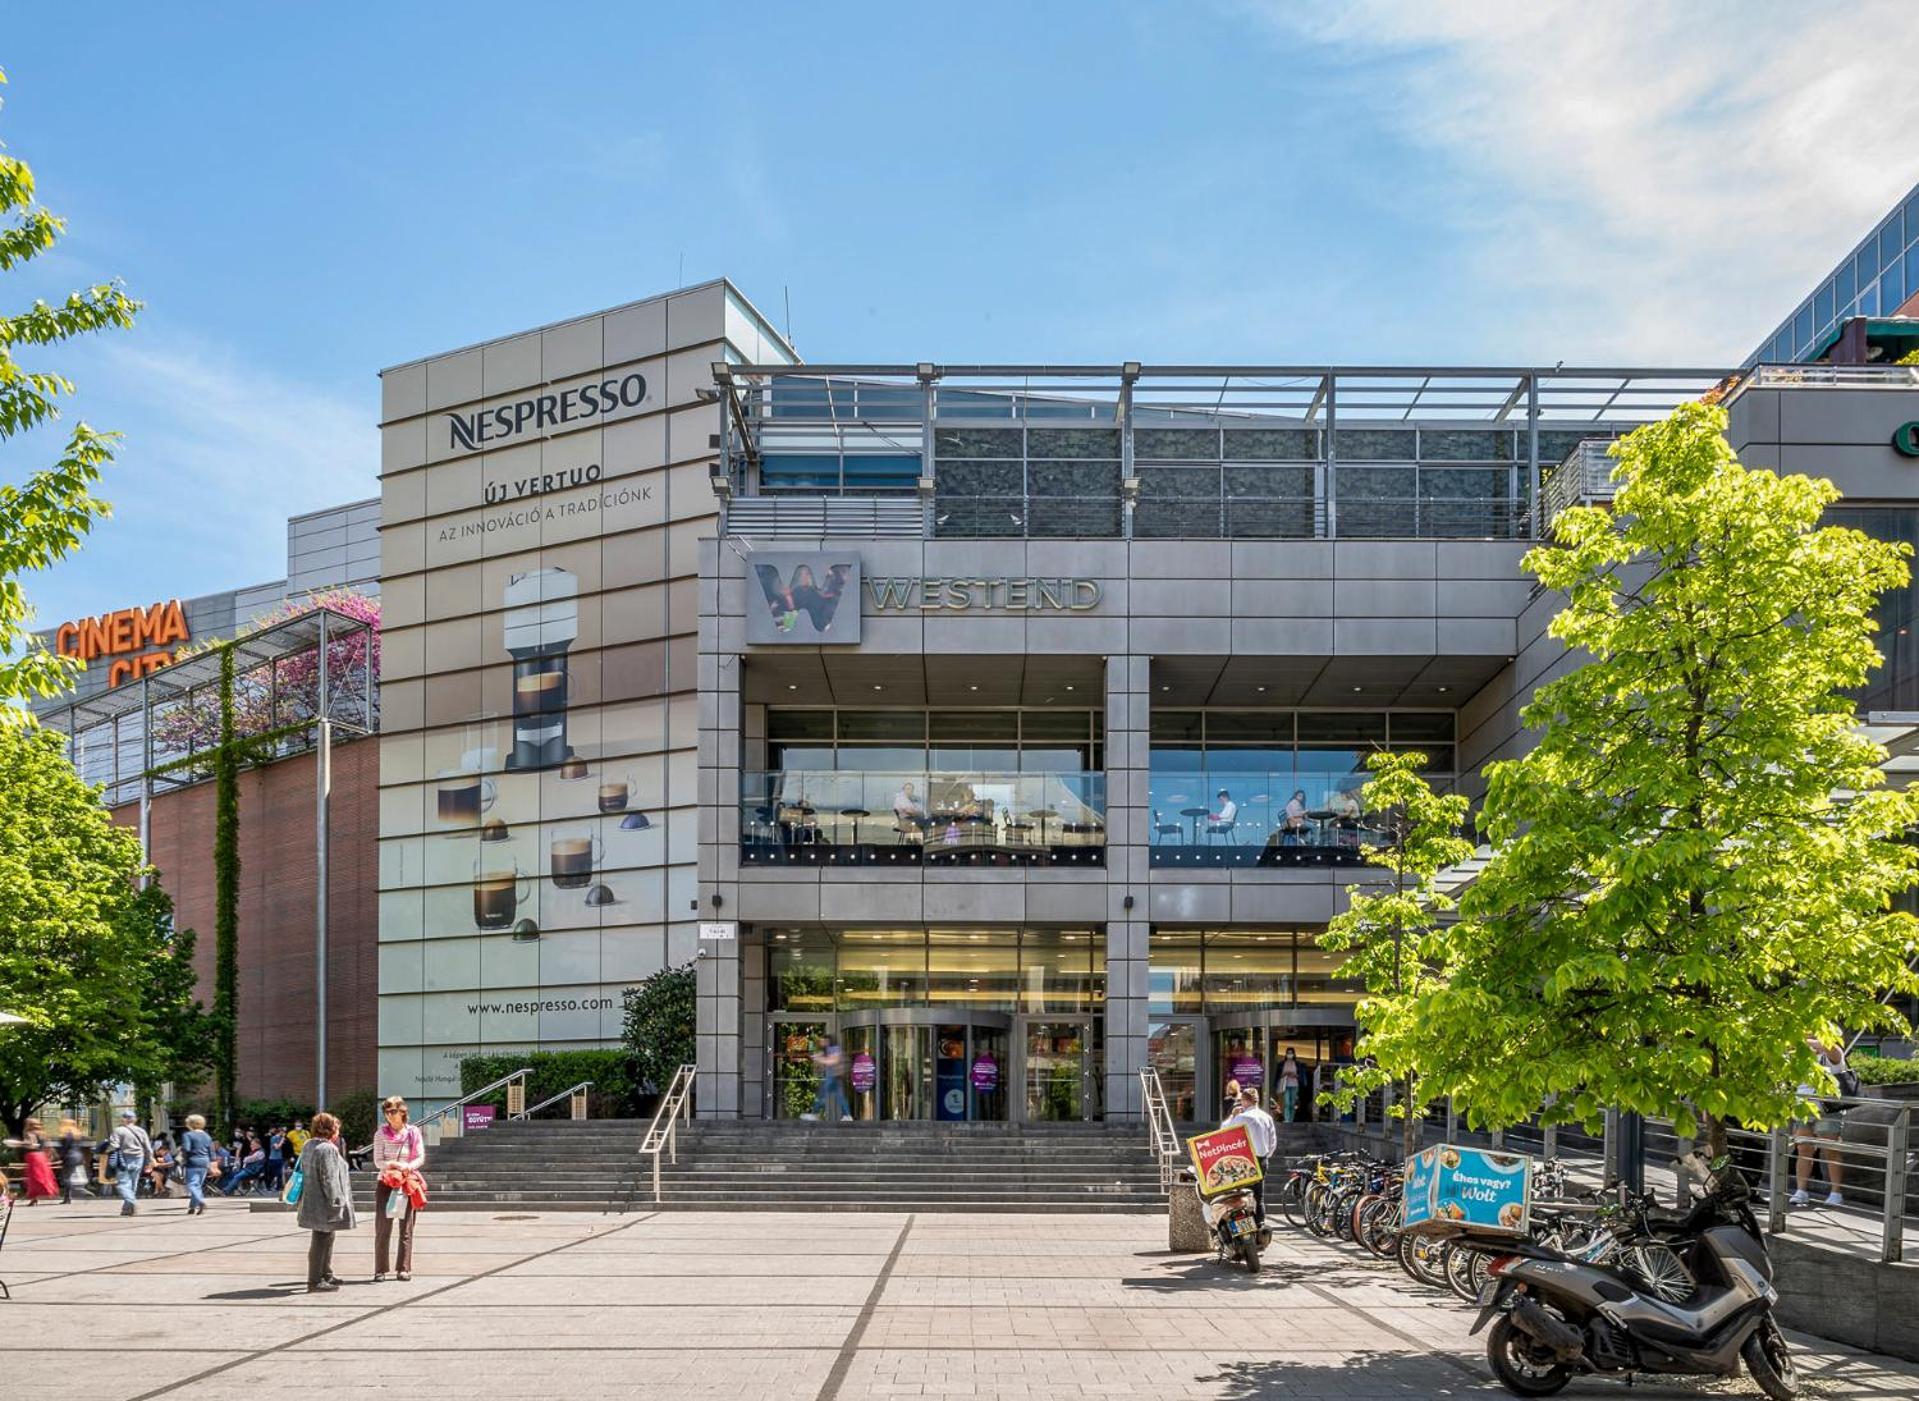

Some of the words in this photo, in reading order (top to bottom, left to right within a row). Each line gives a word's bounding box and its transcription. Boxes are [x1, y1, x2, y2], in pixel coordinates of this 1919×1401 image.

[447, 373, 647, 451] NESPRESSO
[484, 481, 507, 504] ÚJ
[514, 464, 601, 497] VERTUO
[439, 528, 456, 542] AZ
[460, 506, 540, 537] INNOVÁCIÓ
[545, 508, 555, 520] A
[559, 487, 652, 517] TRADICIÓNK
[865, 576, 1104, 611] WESTEND
[56, 599, 190, 661] CINEMA
[108, 651, 174, 689] CIT
[467, 998, 613, 1016] www.nespresso.com
[1461, 1186, 1497, 1203] Wolt
